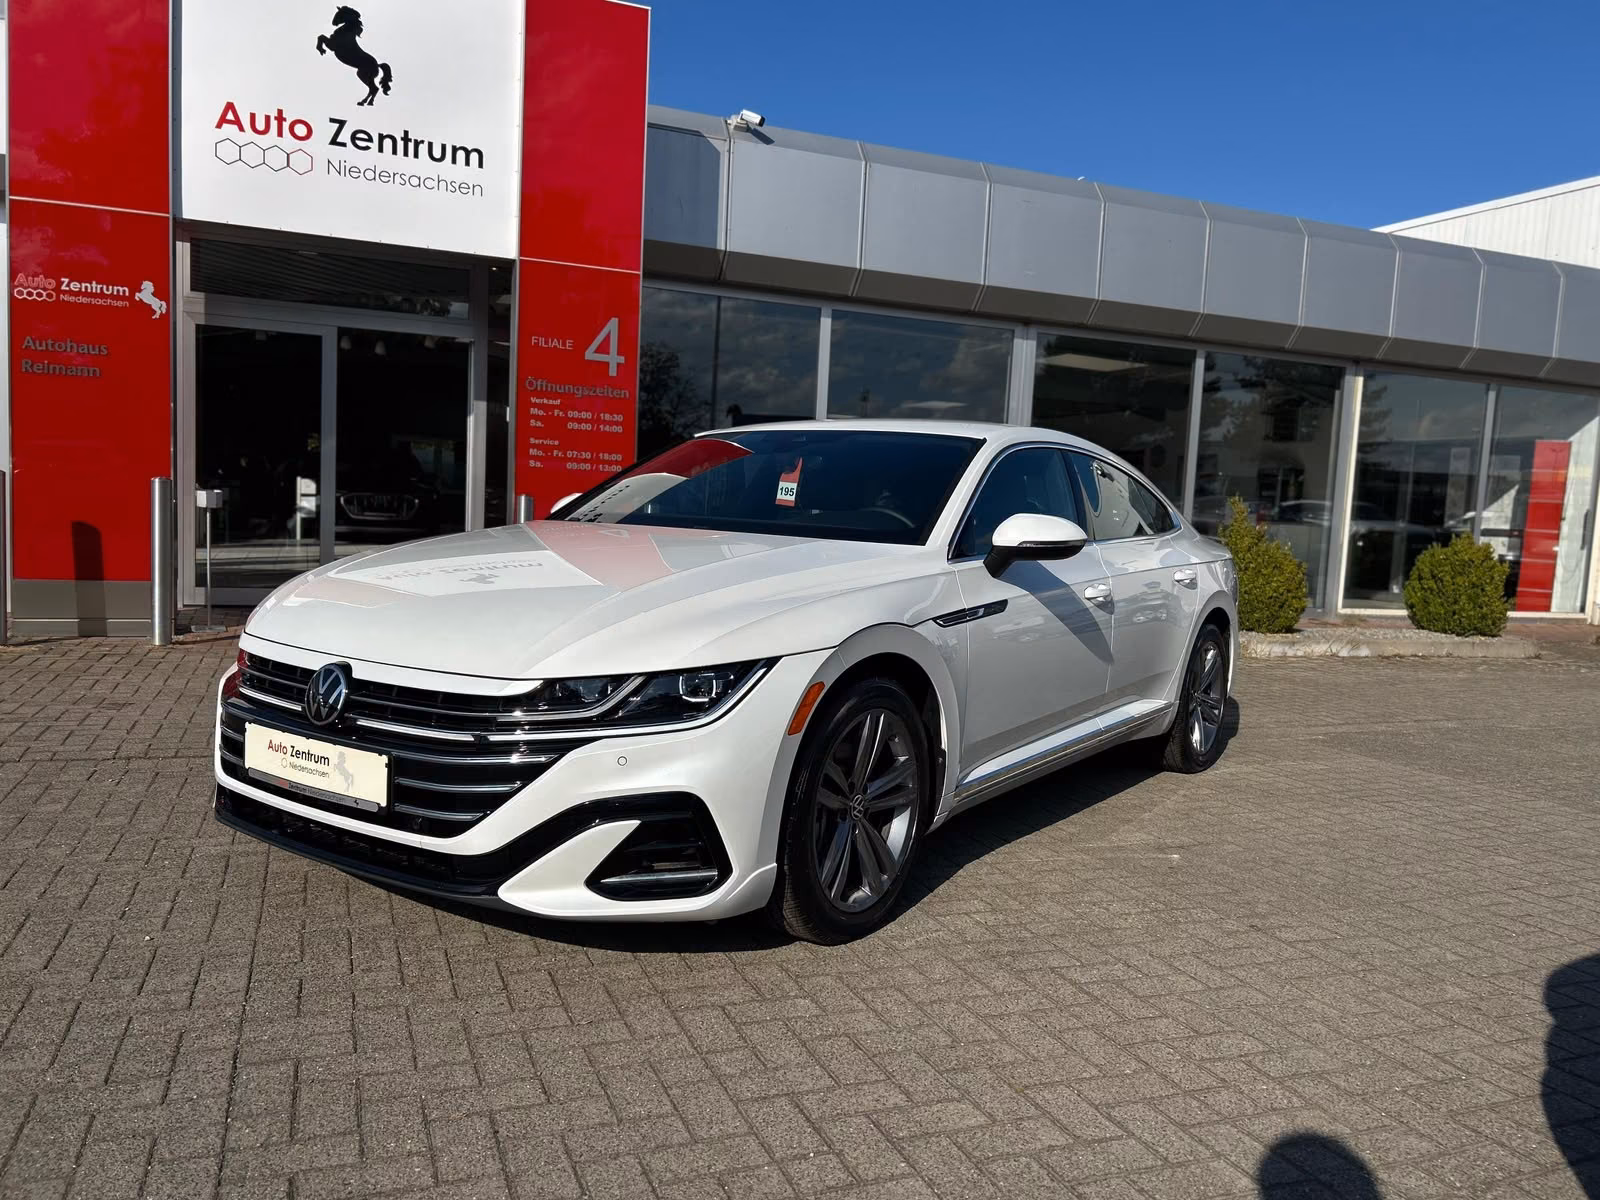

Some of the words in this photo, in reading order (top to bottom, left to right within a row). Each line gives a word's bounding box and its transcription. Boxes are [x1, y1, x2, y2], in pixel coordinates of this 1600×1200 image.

[215, 101, 314, 142] Auto
[328, 117, 485, 169] Zentrum
[327, 158, 484, 197] Niedersachsen
[14, 273, 56, 289] Auto
[60, 278, 130, 296] Zentrum
[60, 294, 130, 308] Niedersachsen
[22, 336, 109, 356] Autohaus
[531, 336, 575, 350] FILIALE
[584, 317, 625, 377] 4
[21, 359, 101, 377] Reimann
[526, 376, 630, 399] Öffnungszeiten
[530, 397, 561, 405] Verkauf
[530, 408, 547, 416] Mo.
[567, 411, 592, 419] 09:00
[600, 413, 624, 422] 18:30
[530, 419, 544, 427] Sa.
[567, 422, 592, 431] 09:00
[600, 424, 623, 433] 14:00
[529, 438, 559, 446] Service
[529, 448, 546, 457] Mo.
[553, 450, 565, 458] Fr.
[566, 450, 592, 460] 07:30
[599, 453, 623, 462] 18:00
[529, 460, 544, 468] Sa.
[566, 462, 591, 471] 09:00
[599, 464, 622, 473] 13:00
[780, 486, 795, 497] 195
[267, 738, 288, 756] Auto
[290, 744, 330, 767] Zentrum
[288, 761, 330, 779] Niedersachsen
